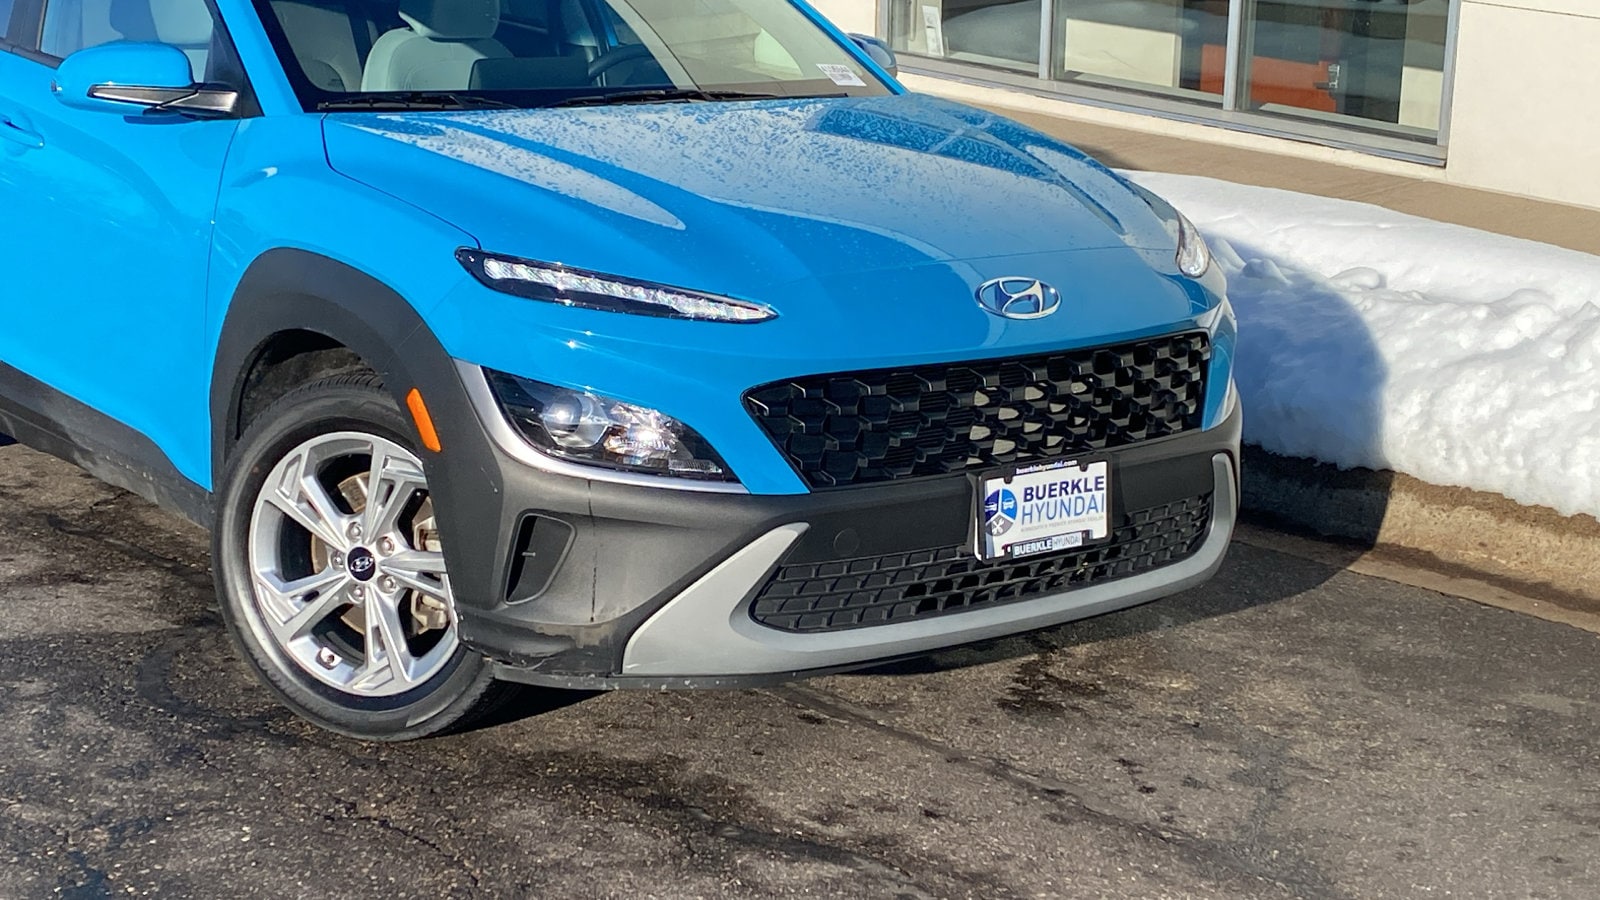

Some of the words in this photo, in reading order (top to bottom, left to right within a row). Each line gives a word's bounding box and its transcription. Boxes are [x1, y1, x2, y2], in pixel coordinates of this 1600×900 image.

[1023, 475, 1105, 502] BUERKLE
[1021, 493, 1105, 526] HYUNDAI
[1014, 539, 1052, 556] BUERKLE
